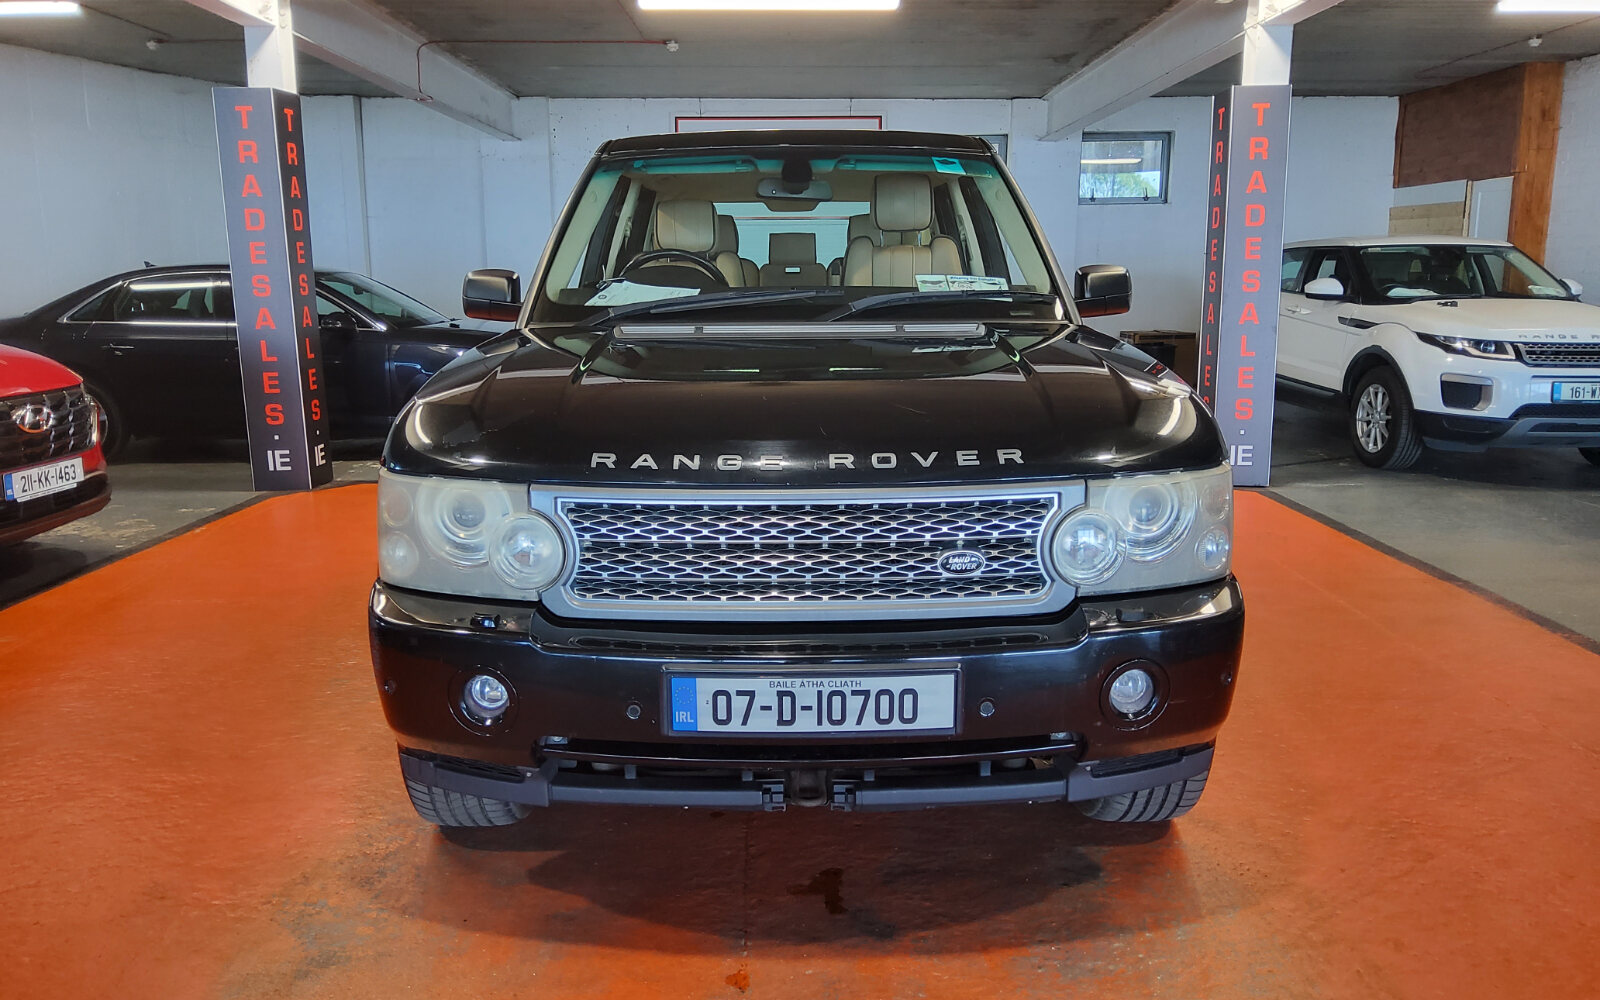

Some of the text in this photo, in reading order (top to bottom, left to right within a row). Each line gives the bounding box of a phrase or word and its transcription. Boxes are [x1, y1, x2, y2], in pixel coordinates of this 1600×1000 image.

[1570, 386, 1600, 399] 161-W
[590, 448, 1025, 471] RANGE ROVER
[20, 464, 77, 494] 211-KK-1463
[769, 680, 797, 689] BAILE
[827, 680, 862, 688] CLIATH
[711, 688, 919, 727] 07-D-10700
[675, 711, 695, 723] IRL
